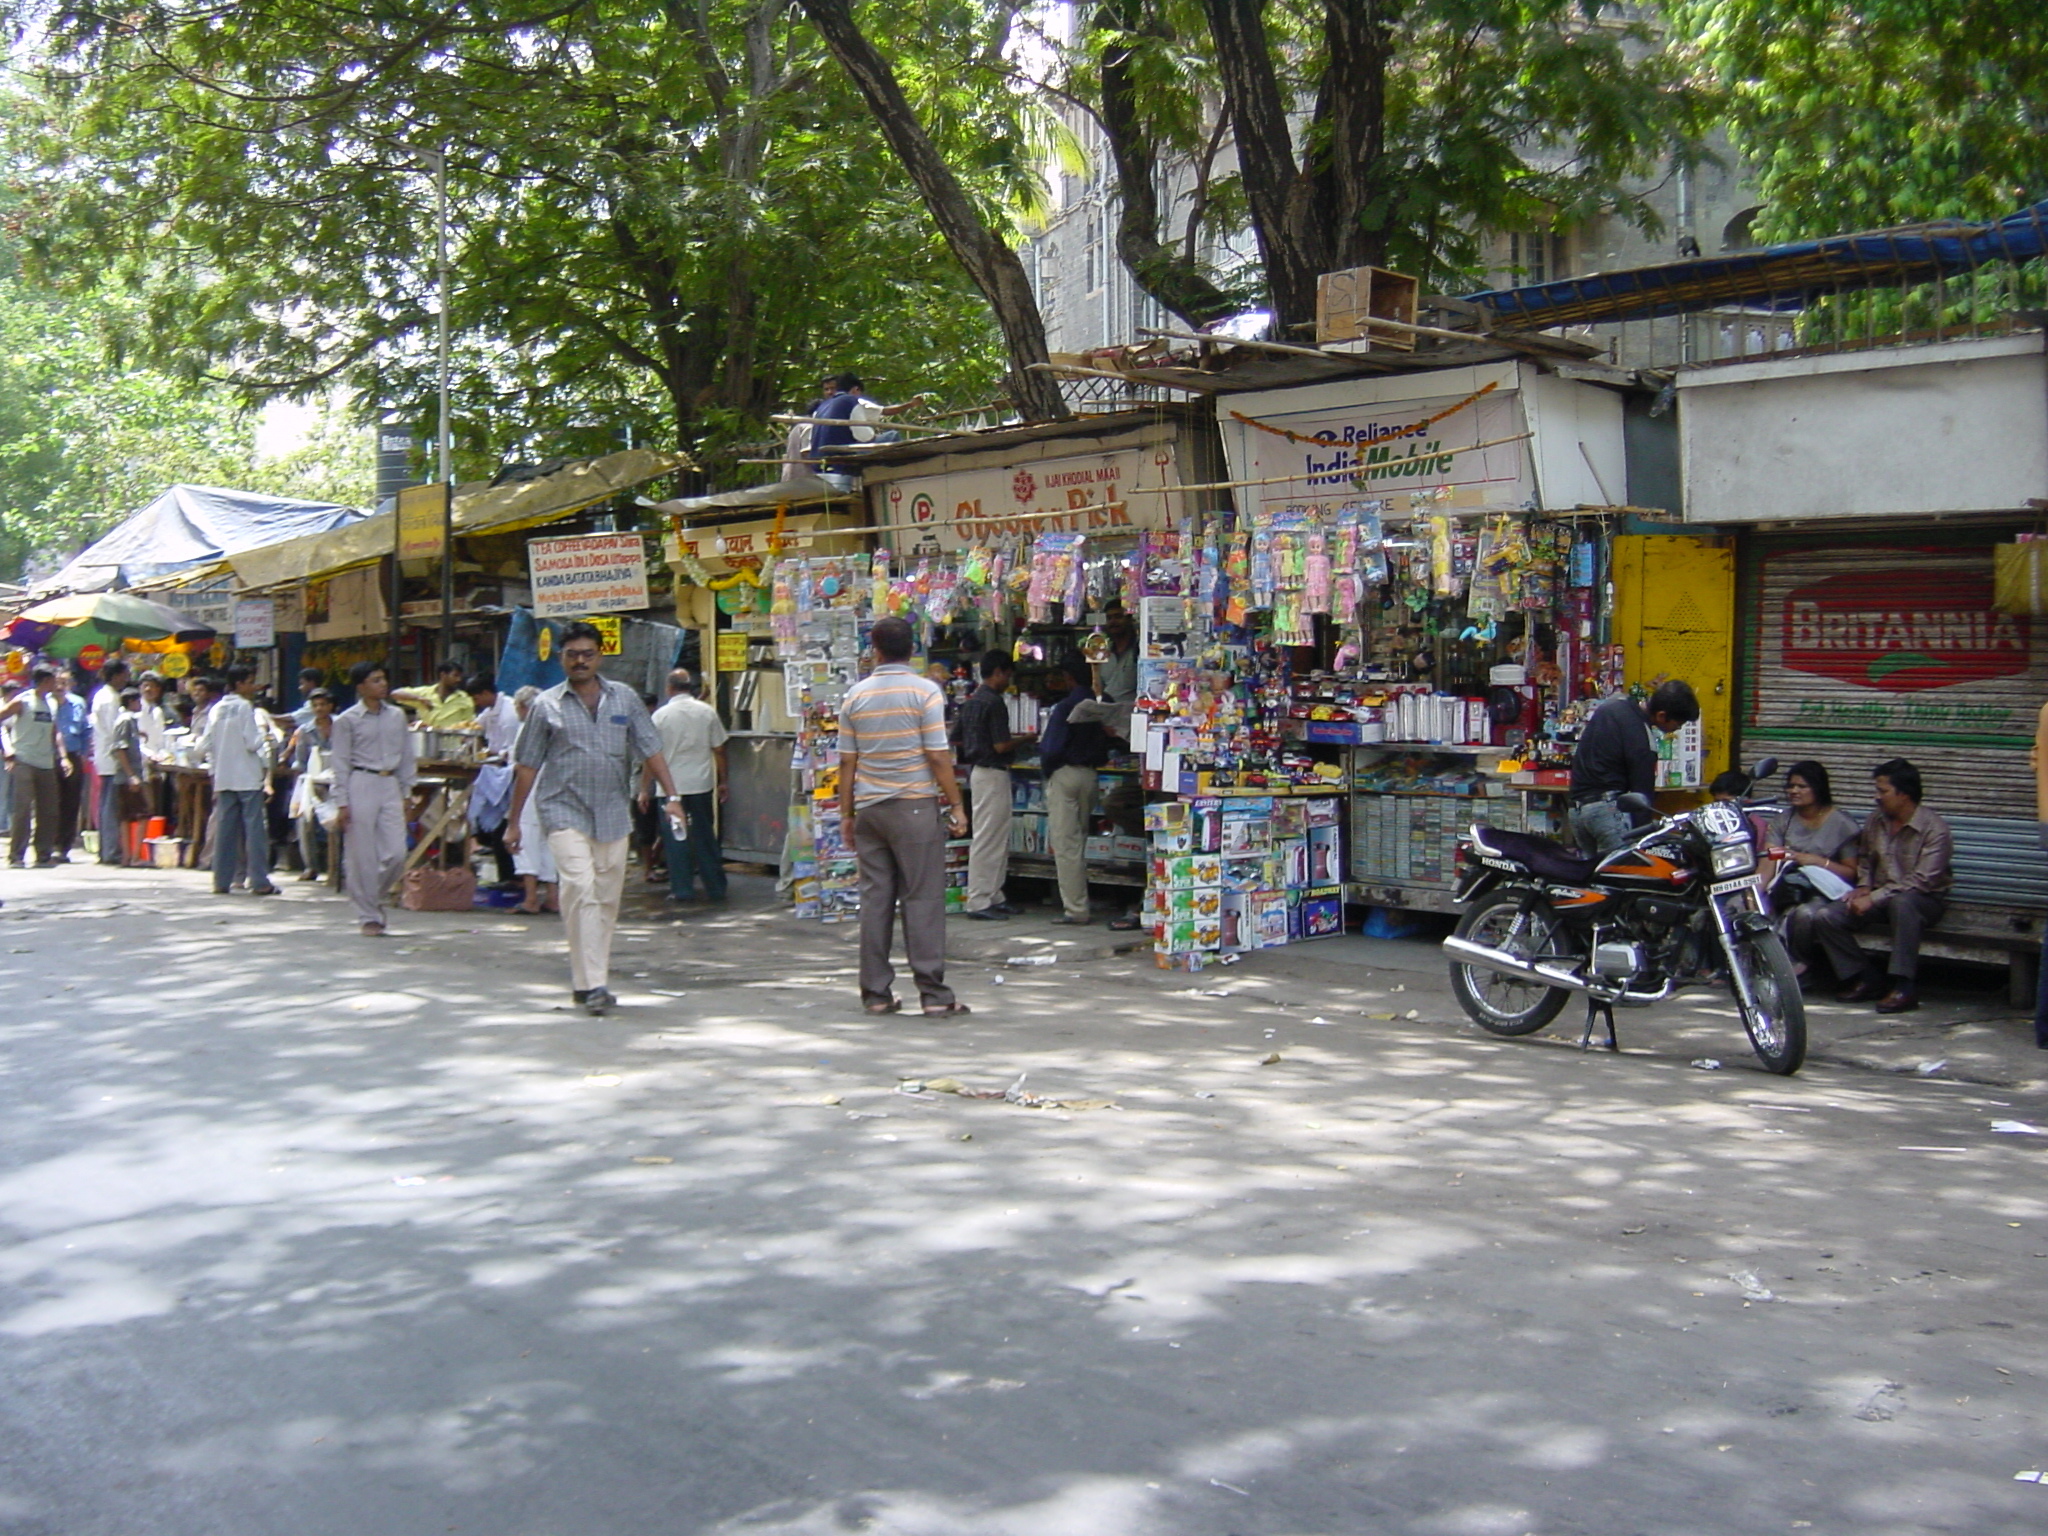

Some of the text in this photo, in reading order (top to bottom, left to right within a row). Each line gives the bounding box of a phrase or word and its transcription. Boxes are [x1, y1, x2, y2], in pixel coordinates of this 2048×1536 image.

[1343, 423, 1427, 444] Reliance
[1066, 484, 1133, 531] Pick
[1792, 601, 2023, 650] BRITANNIA
[1481, 857, 1517, 872] HONDA
[1645, 849, 1676, 860] HONDA
